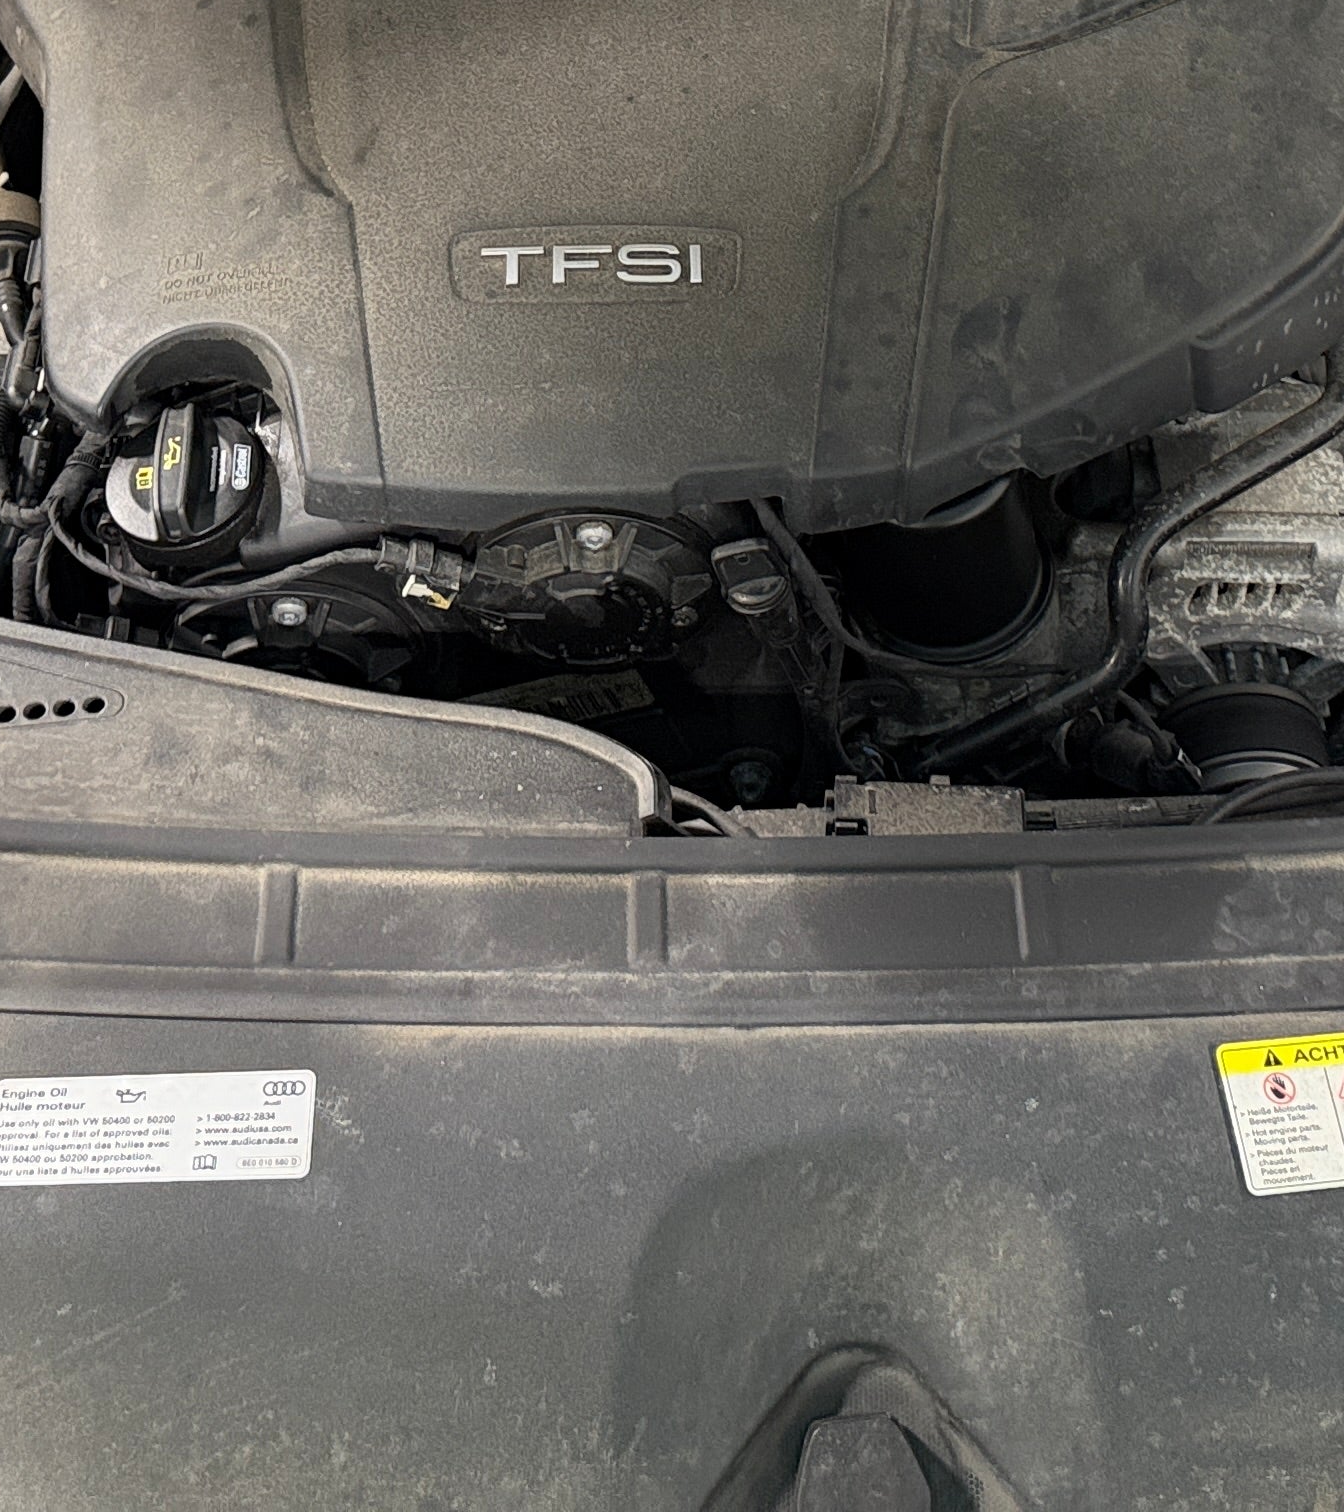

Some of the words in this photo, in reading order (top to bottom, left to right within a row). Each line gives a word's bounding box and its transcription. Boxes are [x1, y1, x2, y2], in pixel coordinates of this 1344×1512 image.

[480, 244, 703, 286] TFSI
[186, 272, 214, 288] NOT
[1, 1088, 45, 1099] Engine
[50, 1087, 67, 1097] Oil
[0, 1102, 32, 1111] Huile
